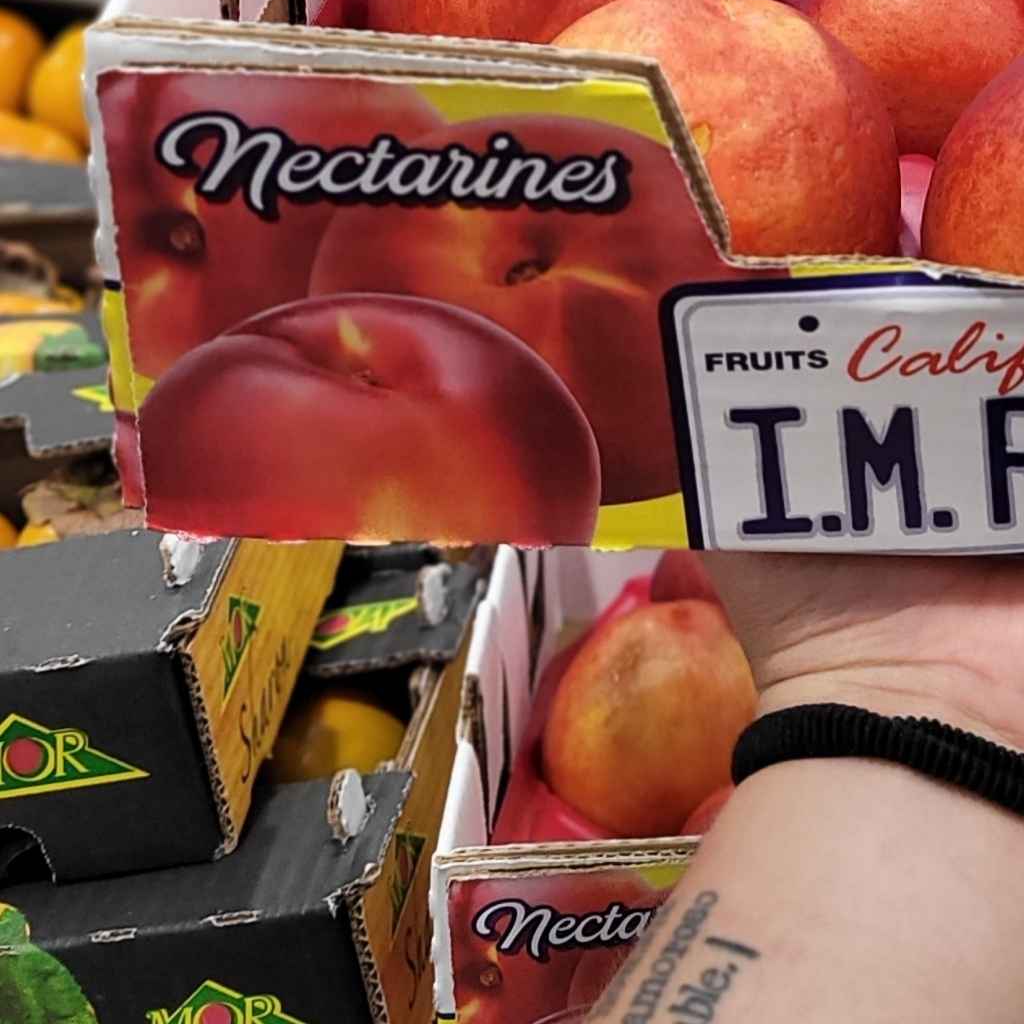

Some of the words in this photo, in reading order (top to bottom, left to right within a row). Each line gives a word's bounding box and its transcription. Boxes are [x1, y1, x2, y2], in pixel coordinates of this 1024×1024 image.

[160, 114, 626, 214] Nectarines
[704, 348, 830, 373] FRUITS
[728, 405, 957, 537] I.M.
[0, 731, 90, 785] OR
